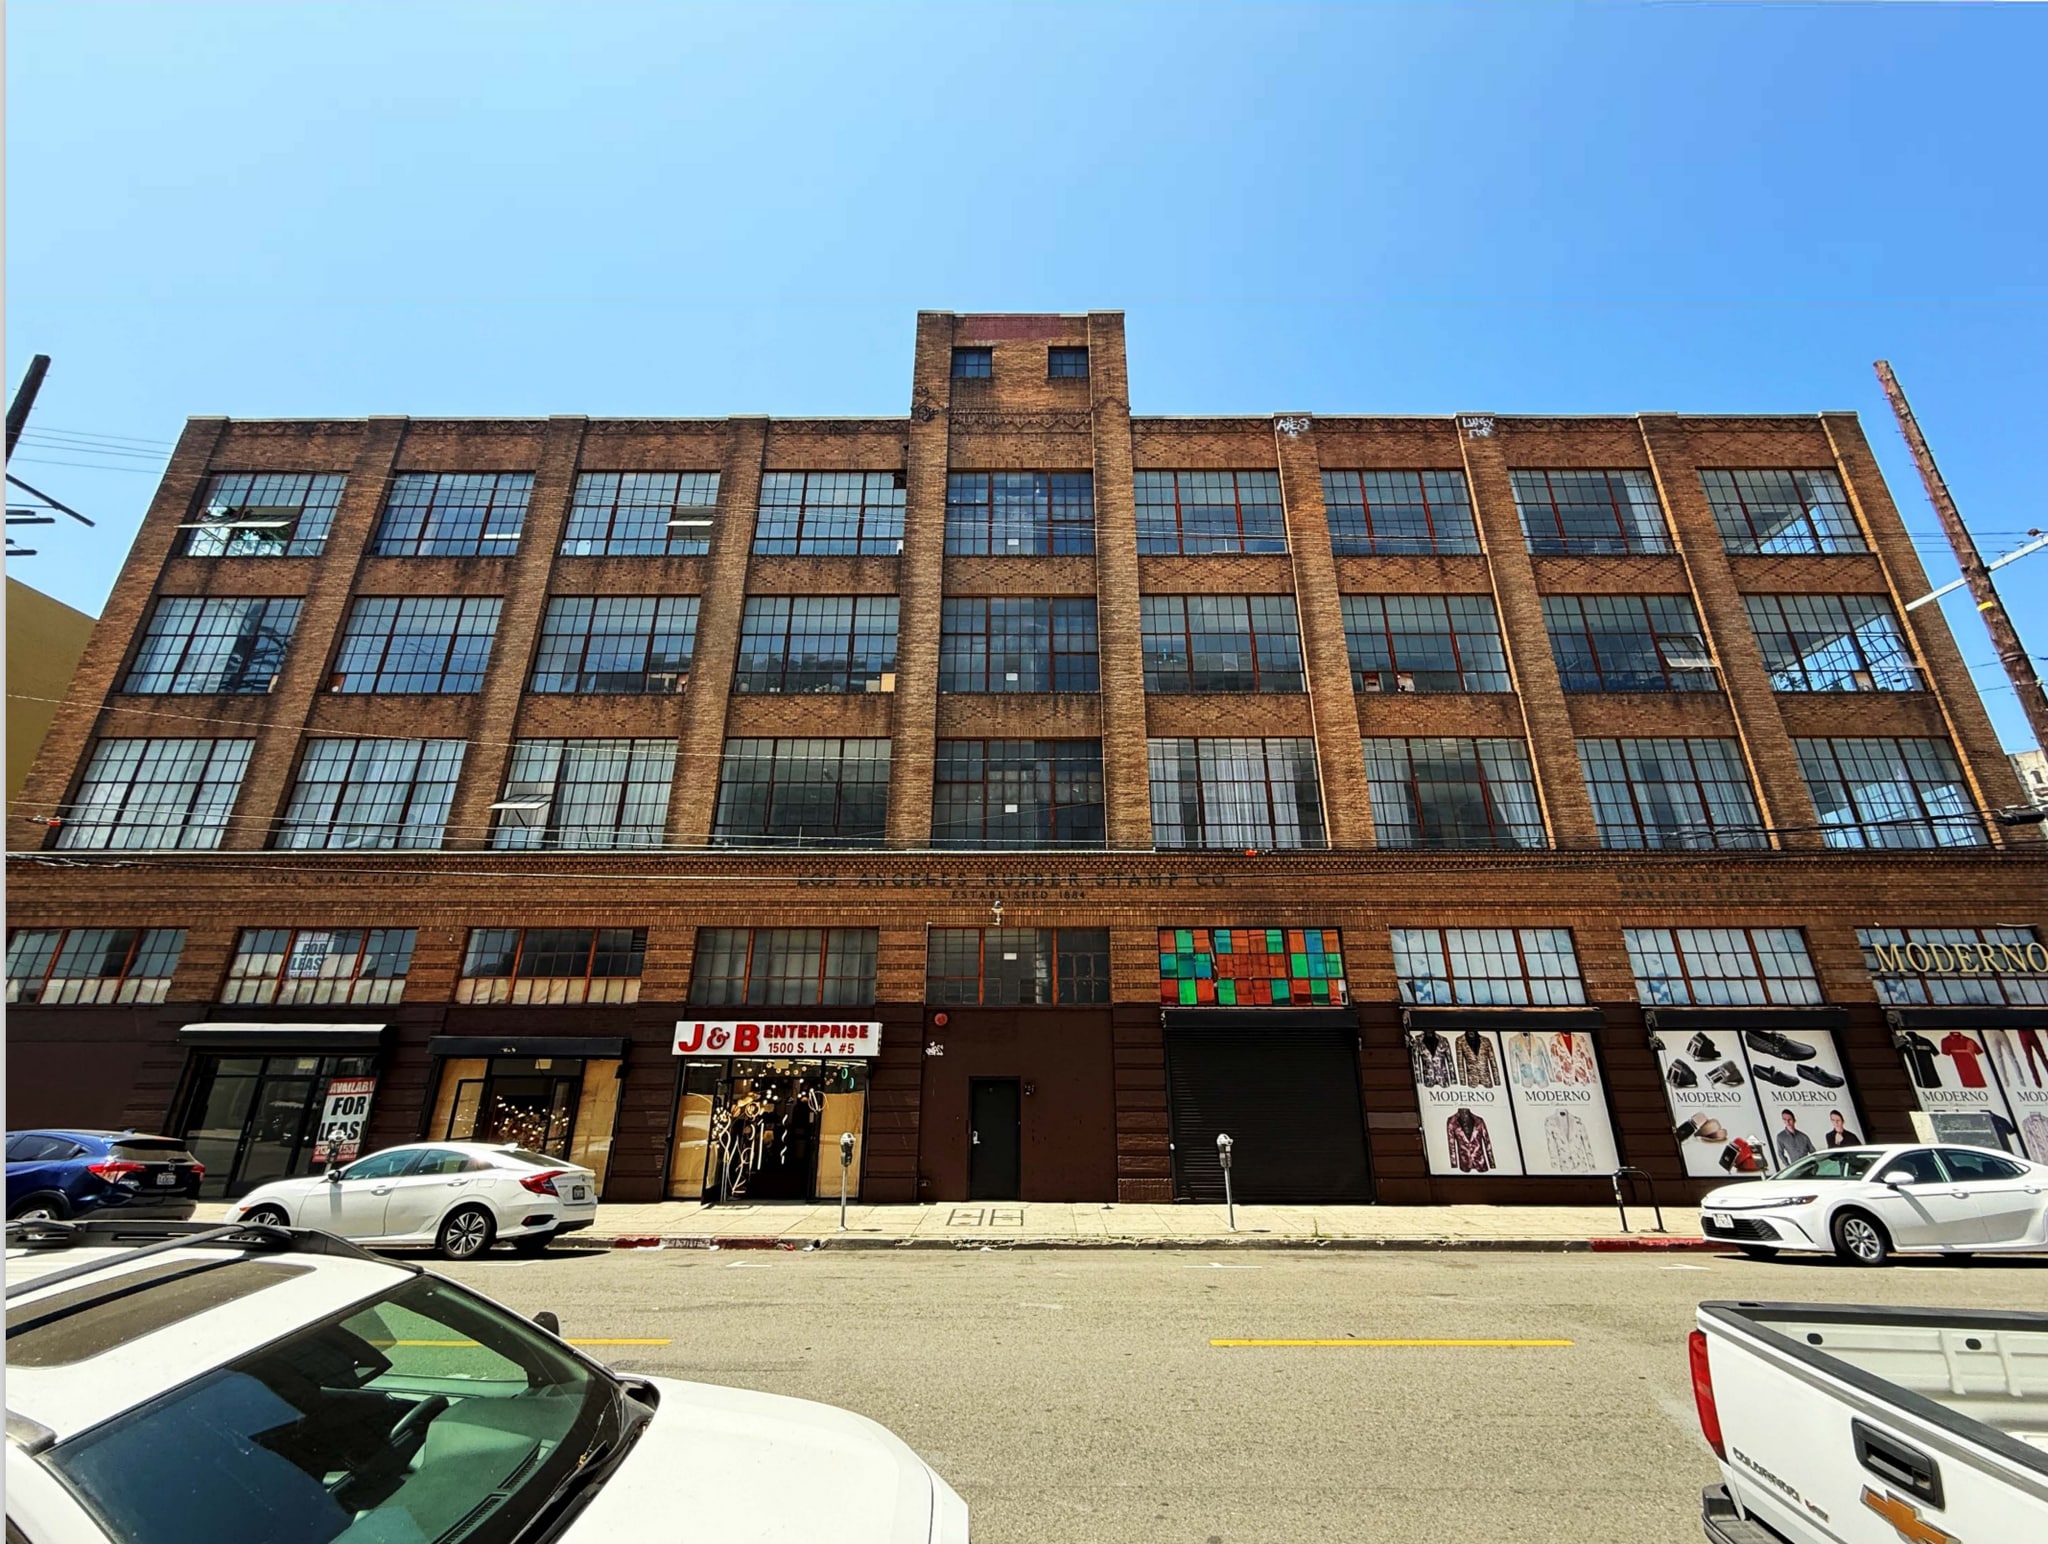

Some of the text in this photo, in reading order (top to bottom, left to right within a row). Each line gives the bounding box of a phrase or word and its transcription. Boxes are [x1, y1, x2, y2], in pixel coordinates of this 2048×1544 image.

[309, 875, 361, 884] NAME
[371, 875, 432, 884] PLATES
[797, 872, 837, 887] LOS
[858, 872, 967, 887] ANGELES
[985, 872, 1080, 887] RUBBER
[1095, 871, 1179, 888] STAMP
[1616, 875, 1785, 884] RUBBER AND METAL
[951, 890, 1086, 900] ESTABLISHED 1884
[301, 943, 327, 956] FOR
[1871, 942, 2048, 973] MODERNO
[763, 1025, 869, 1039] ENTERPRISE
[768, 1043, 794, 1054] 1500
[838, 1043, 855, 1054] #5
[329, 1081, 374, 1094] AVAILABL
[1429, 1090, 1495, 1103] MODERNO
[1525, 1090, 1591, 1102] MODERNO
[1676, 1092, 1742, 1104] MODERNO
[1771, 1090, 1837, 1103] MODERNO
[1922, 1090, 1989, 1103] MODERNO
[2017, 1091, 2048, 1102] MOD
[331, 1096, 367, 1116] FOR
